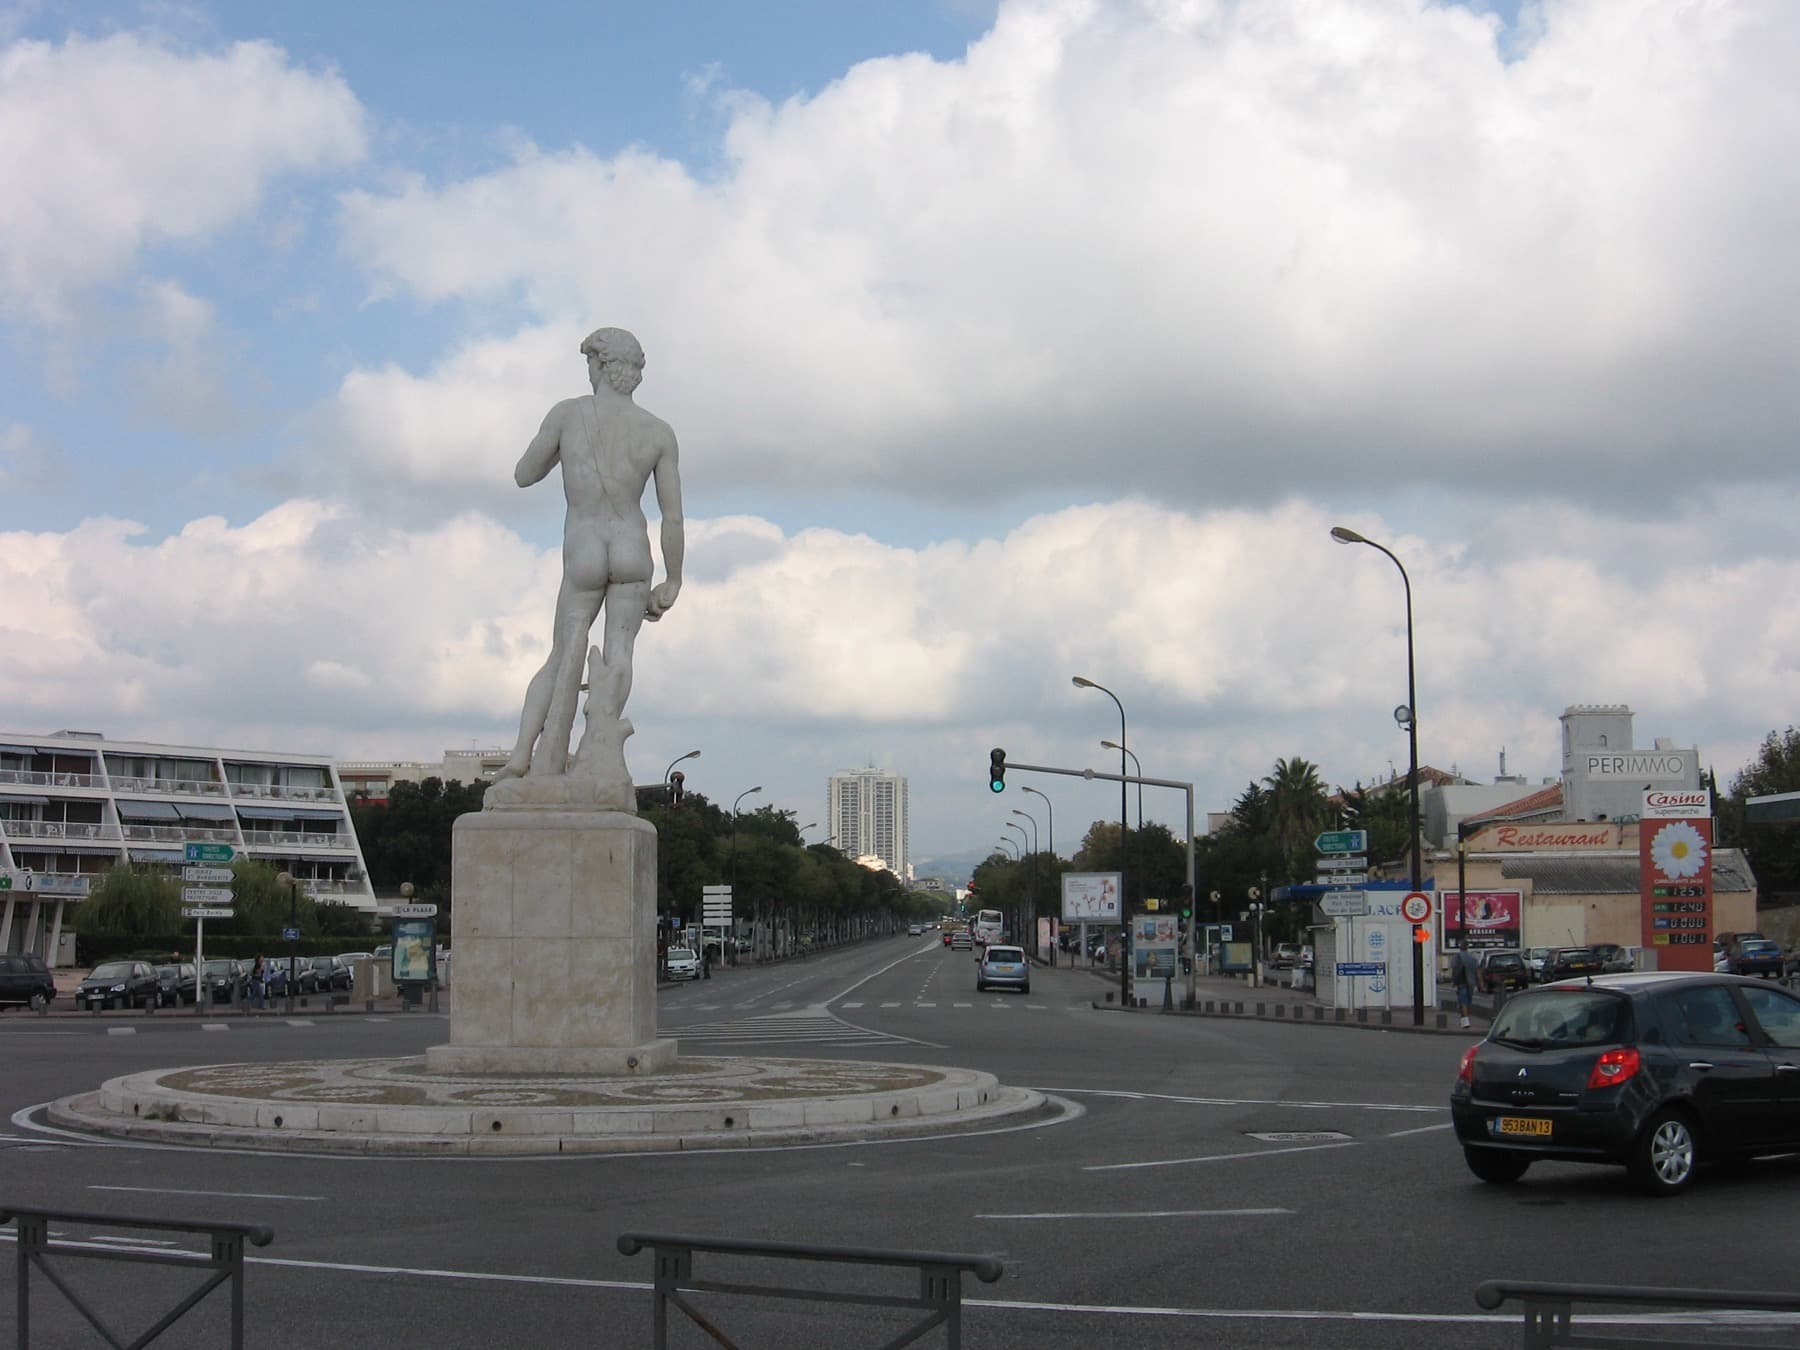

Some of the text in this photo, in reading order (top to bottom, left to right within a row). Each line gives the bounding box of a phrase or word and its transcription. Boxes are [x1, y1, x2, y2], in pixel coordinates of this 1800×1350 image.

[1588, 757, 1683, 774] PERIMMO
[1646, 791, 1705, 807] Casino
[1497, 827, 1609, 847] Restaurant
